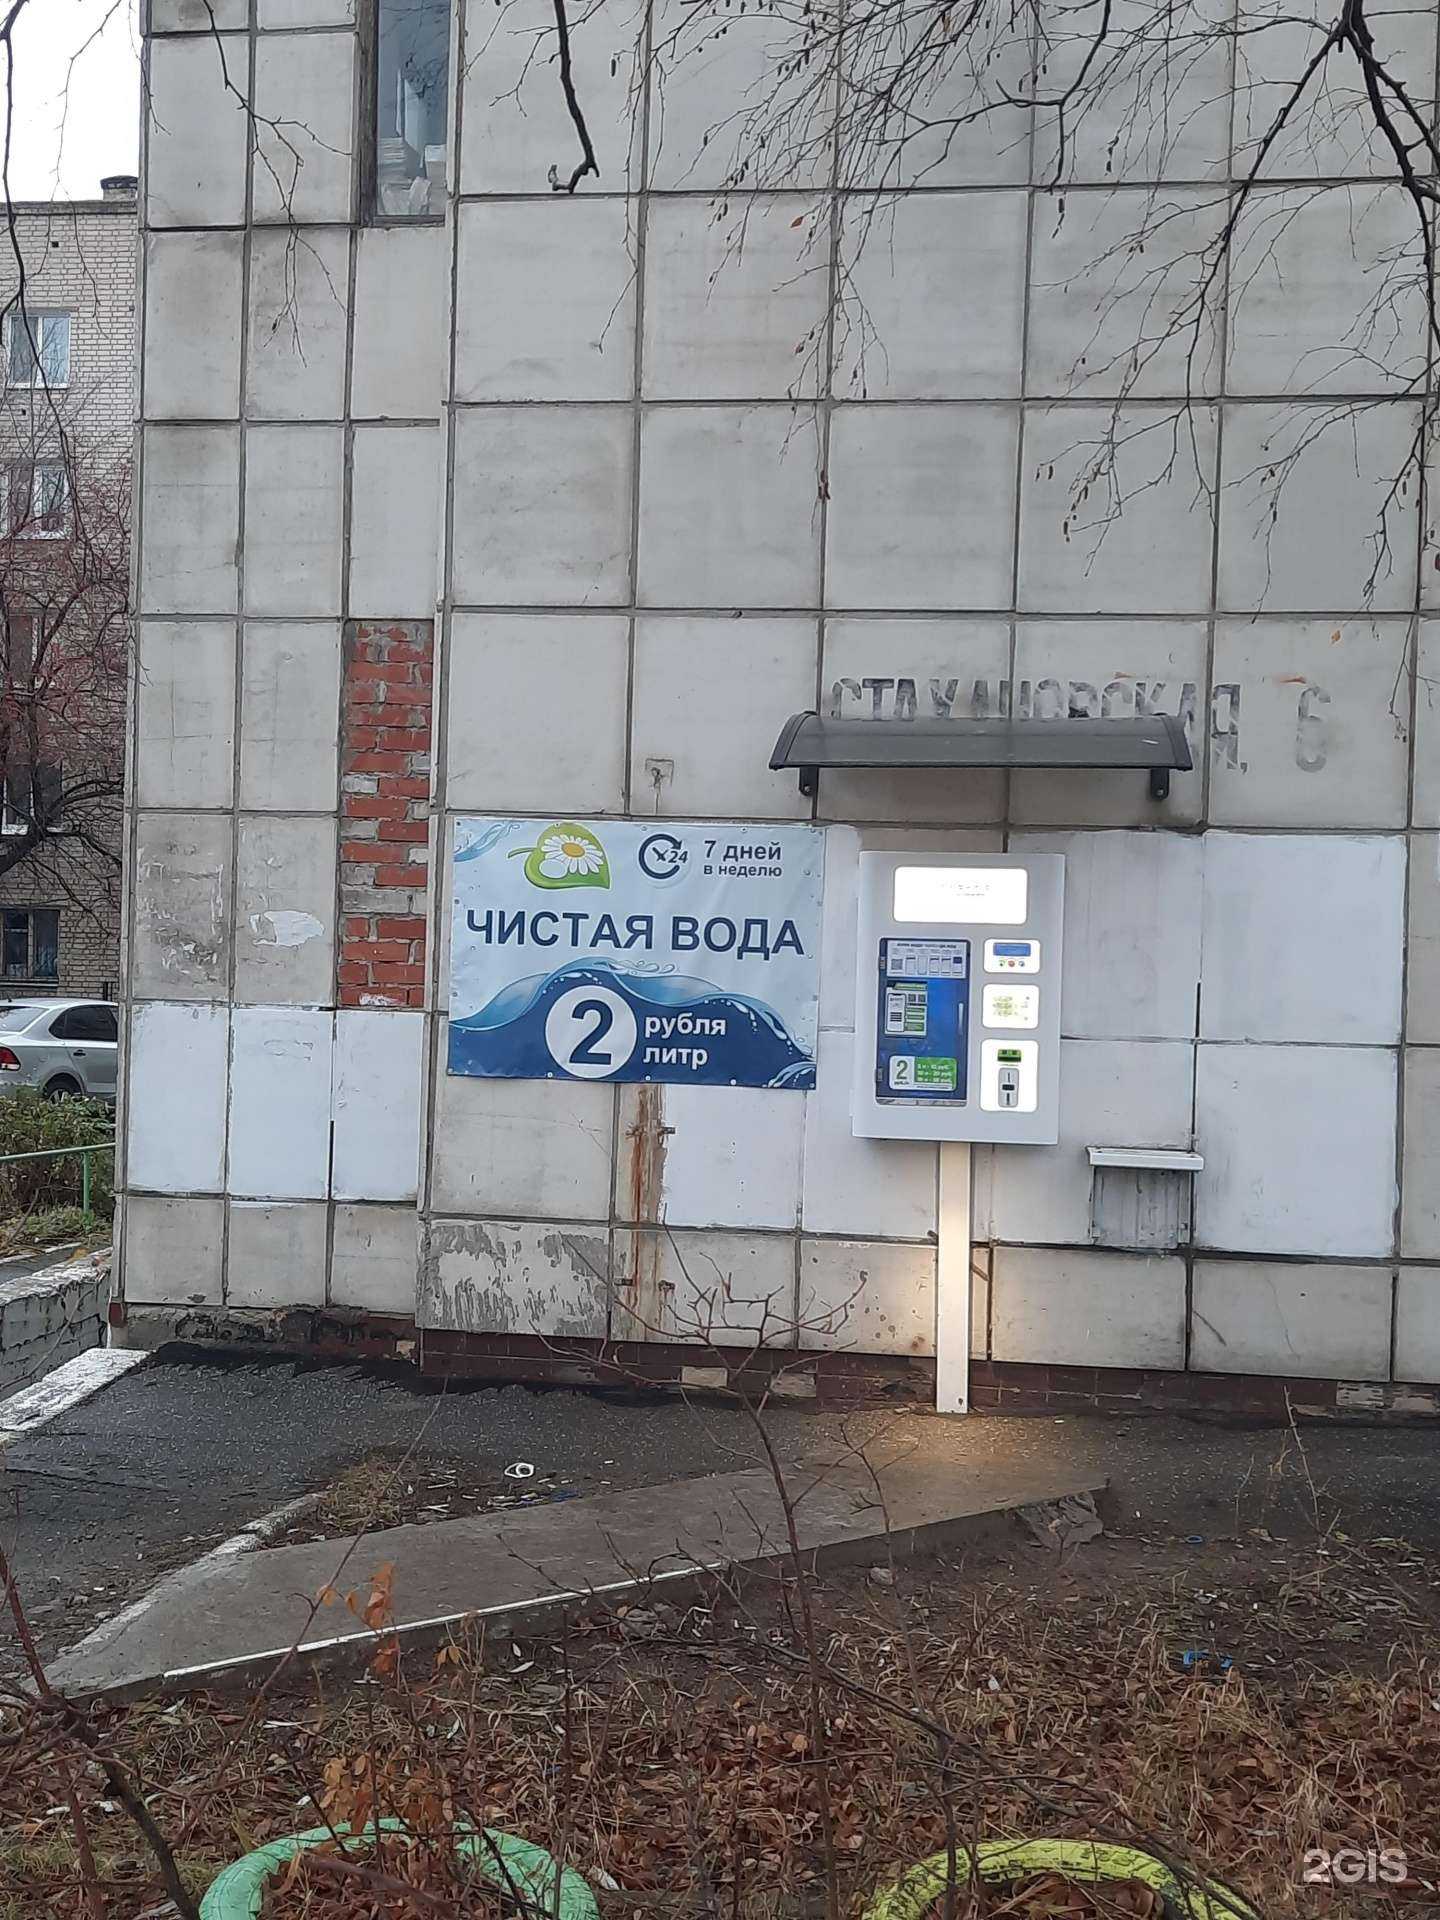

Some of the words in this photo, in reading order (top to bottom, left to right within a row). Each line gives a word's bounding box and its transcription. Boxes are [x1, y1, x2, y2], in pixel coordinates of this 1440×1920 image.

[704, 840, 716, 858] 7
[723, 841, 782, 862] дней
[704, 865, 713, 875] в
[718, 865, 782, 878] неделю
[467, 910, 653, 949] ЧИСТАЯ
[671, 917, 804, 960] ВОДА
[570, 999, 613, 1065] 2
[644, 1013, 726, 1039] рубля
[643, 1046, 708, 1069] литр
[896, 1060, 908, 1079] 2
